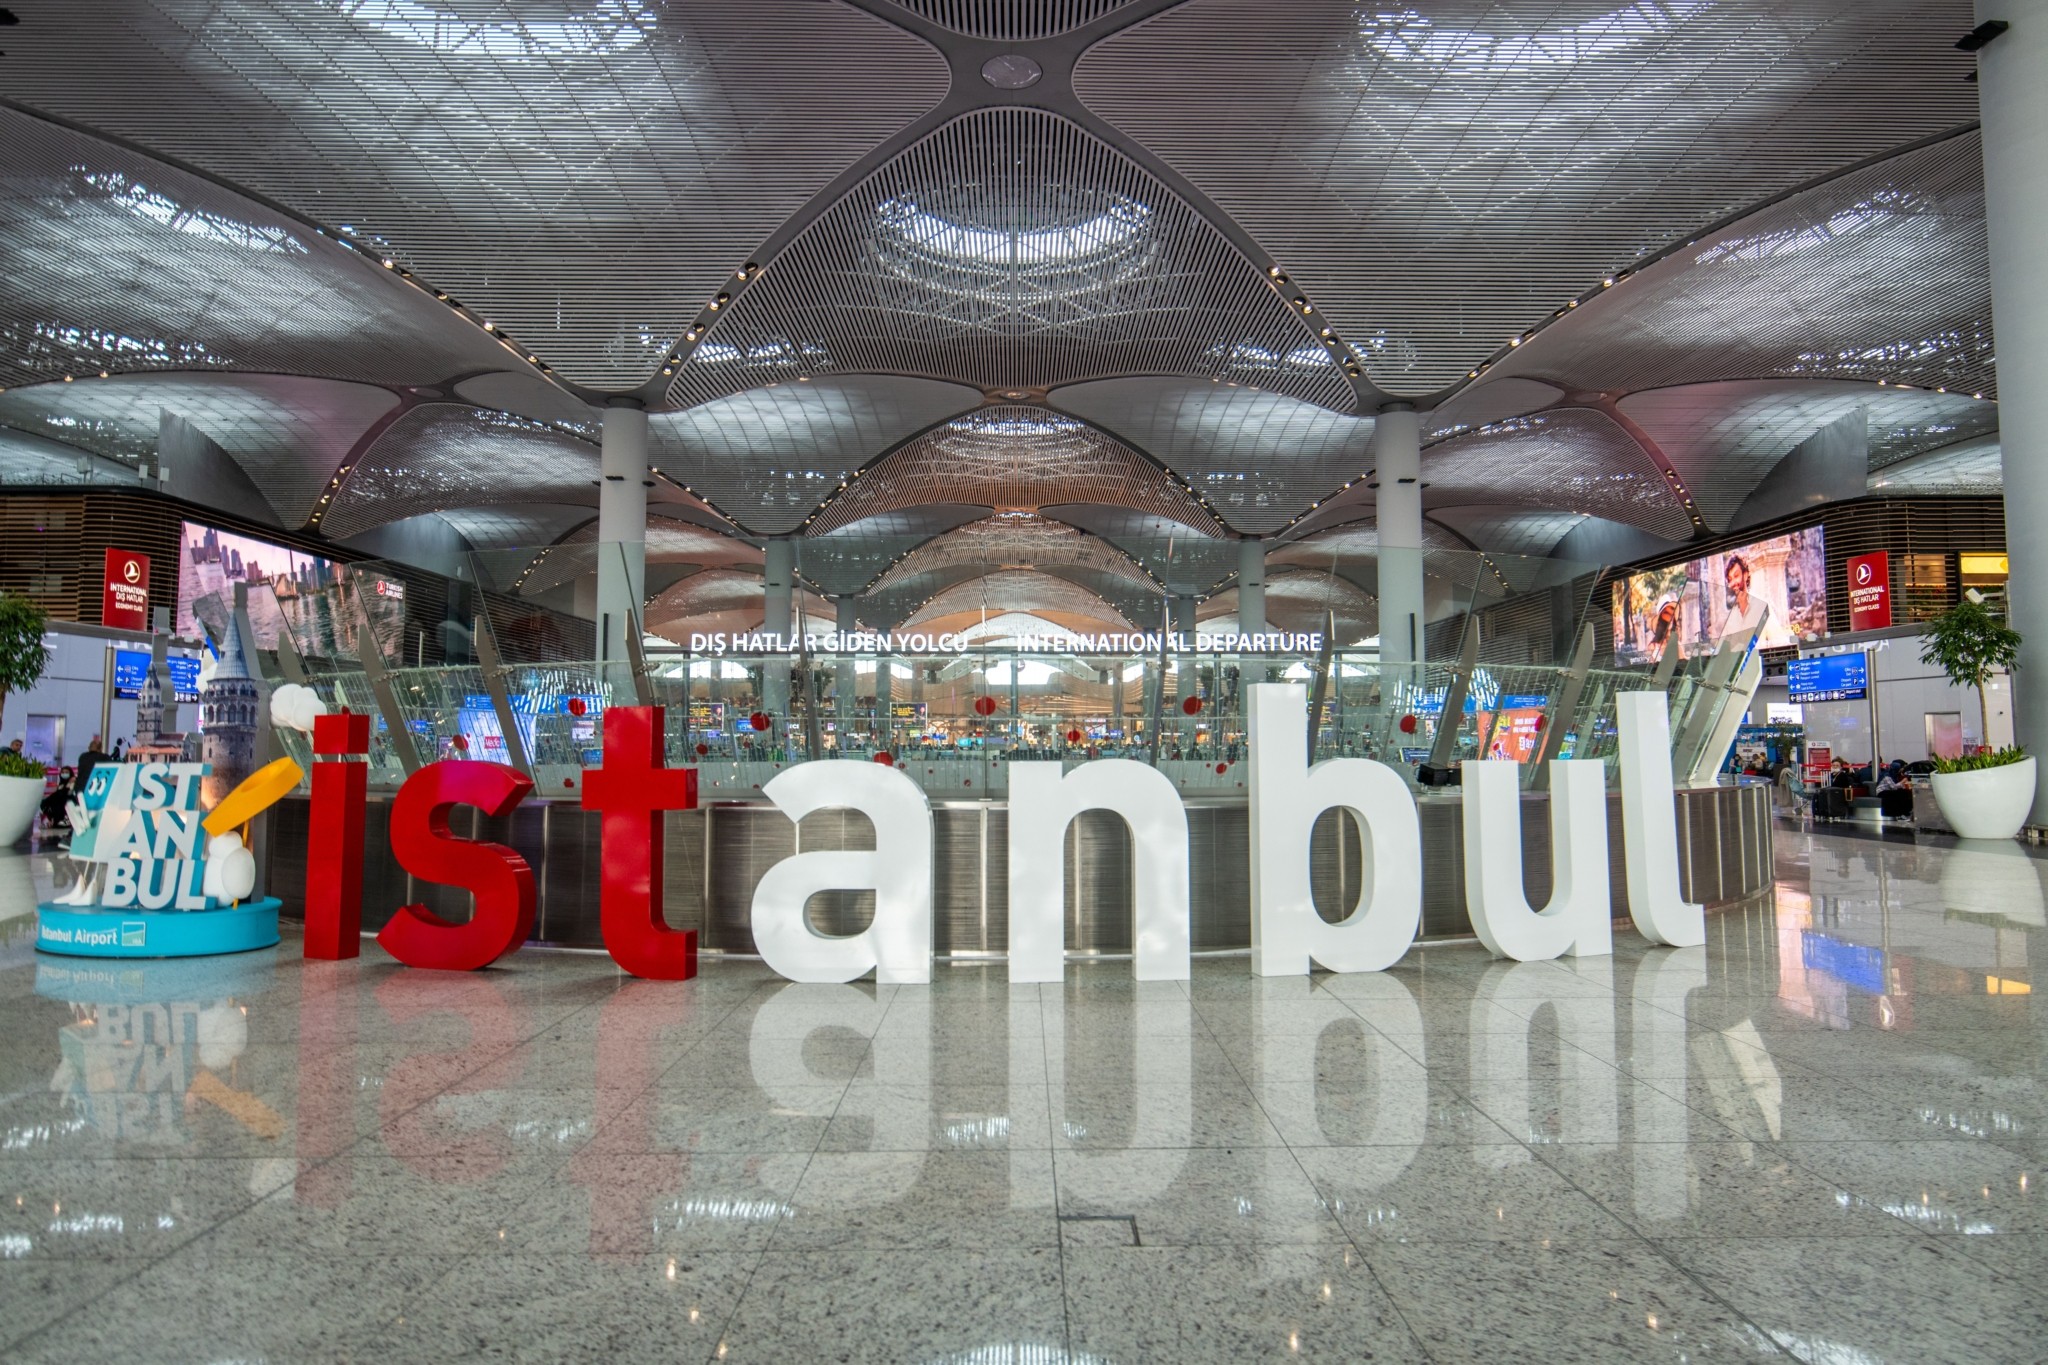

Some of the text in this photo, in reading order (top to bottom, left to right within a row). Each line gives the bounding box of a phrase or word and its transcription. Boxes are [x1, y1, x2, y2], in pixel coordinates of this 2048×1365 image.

[110, 582, 147, 597] INTERNATIONAL
[386, 582, 403, 592] TURKISH
[386, 590, 403, 599] AIRLINES
[1861, 594, 1879, 603] HATLAR
[691, 629, 968, 656] DIŞ HATLAR GİDEN YOLCU
[1017, 633, 1322, 652] INTERNATIONAL DEPARTURE
[117, 763, 205, 811] IST
[107, 809, 202, 860] AN
[303, 682, 1707, 985] istanbul
[101, 857, 207, 911] BUL
[74, 928, 118, 947] Airport
